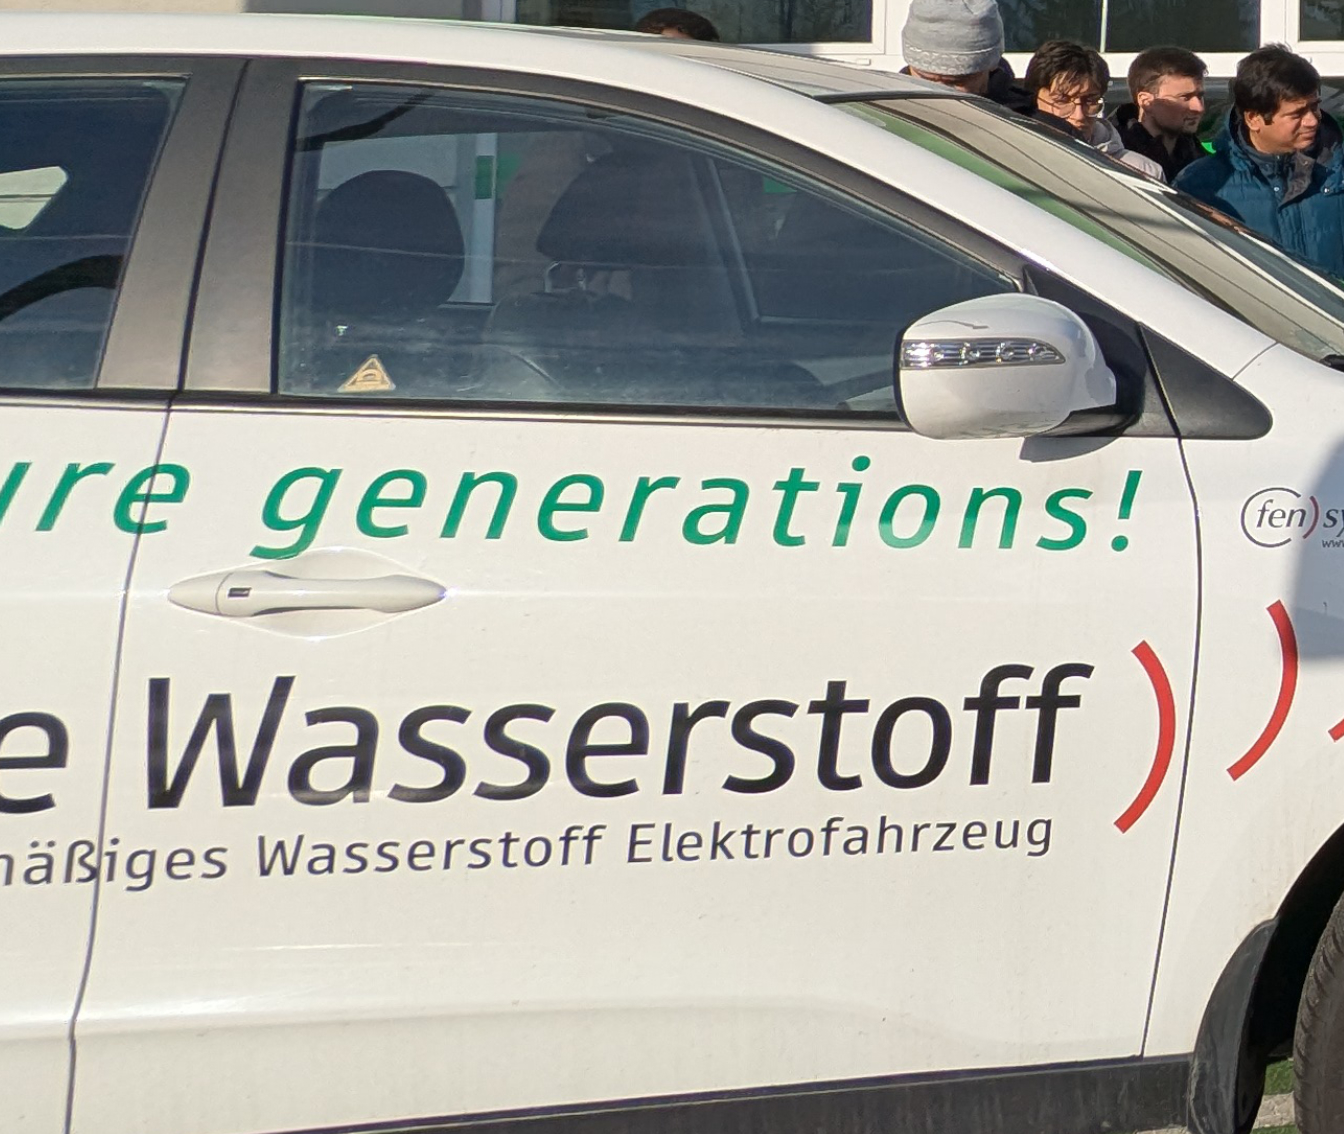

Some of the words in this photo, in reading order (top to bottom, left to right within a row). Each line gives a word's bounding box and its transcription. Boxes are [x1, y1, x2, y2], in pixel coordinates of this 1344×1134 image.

[252, 456, 1142, 560] generations!
[147, 663, 1095, 810] Wasserstoff
[258, 824, 608, 878] Wasserstoff
[627, 815, 1053, 865] Elektrofahrzeug
